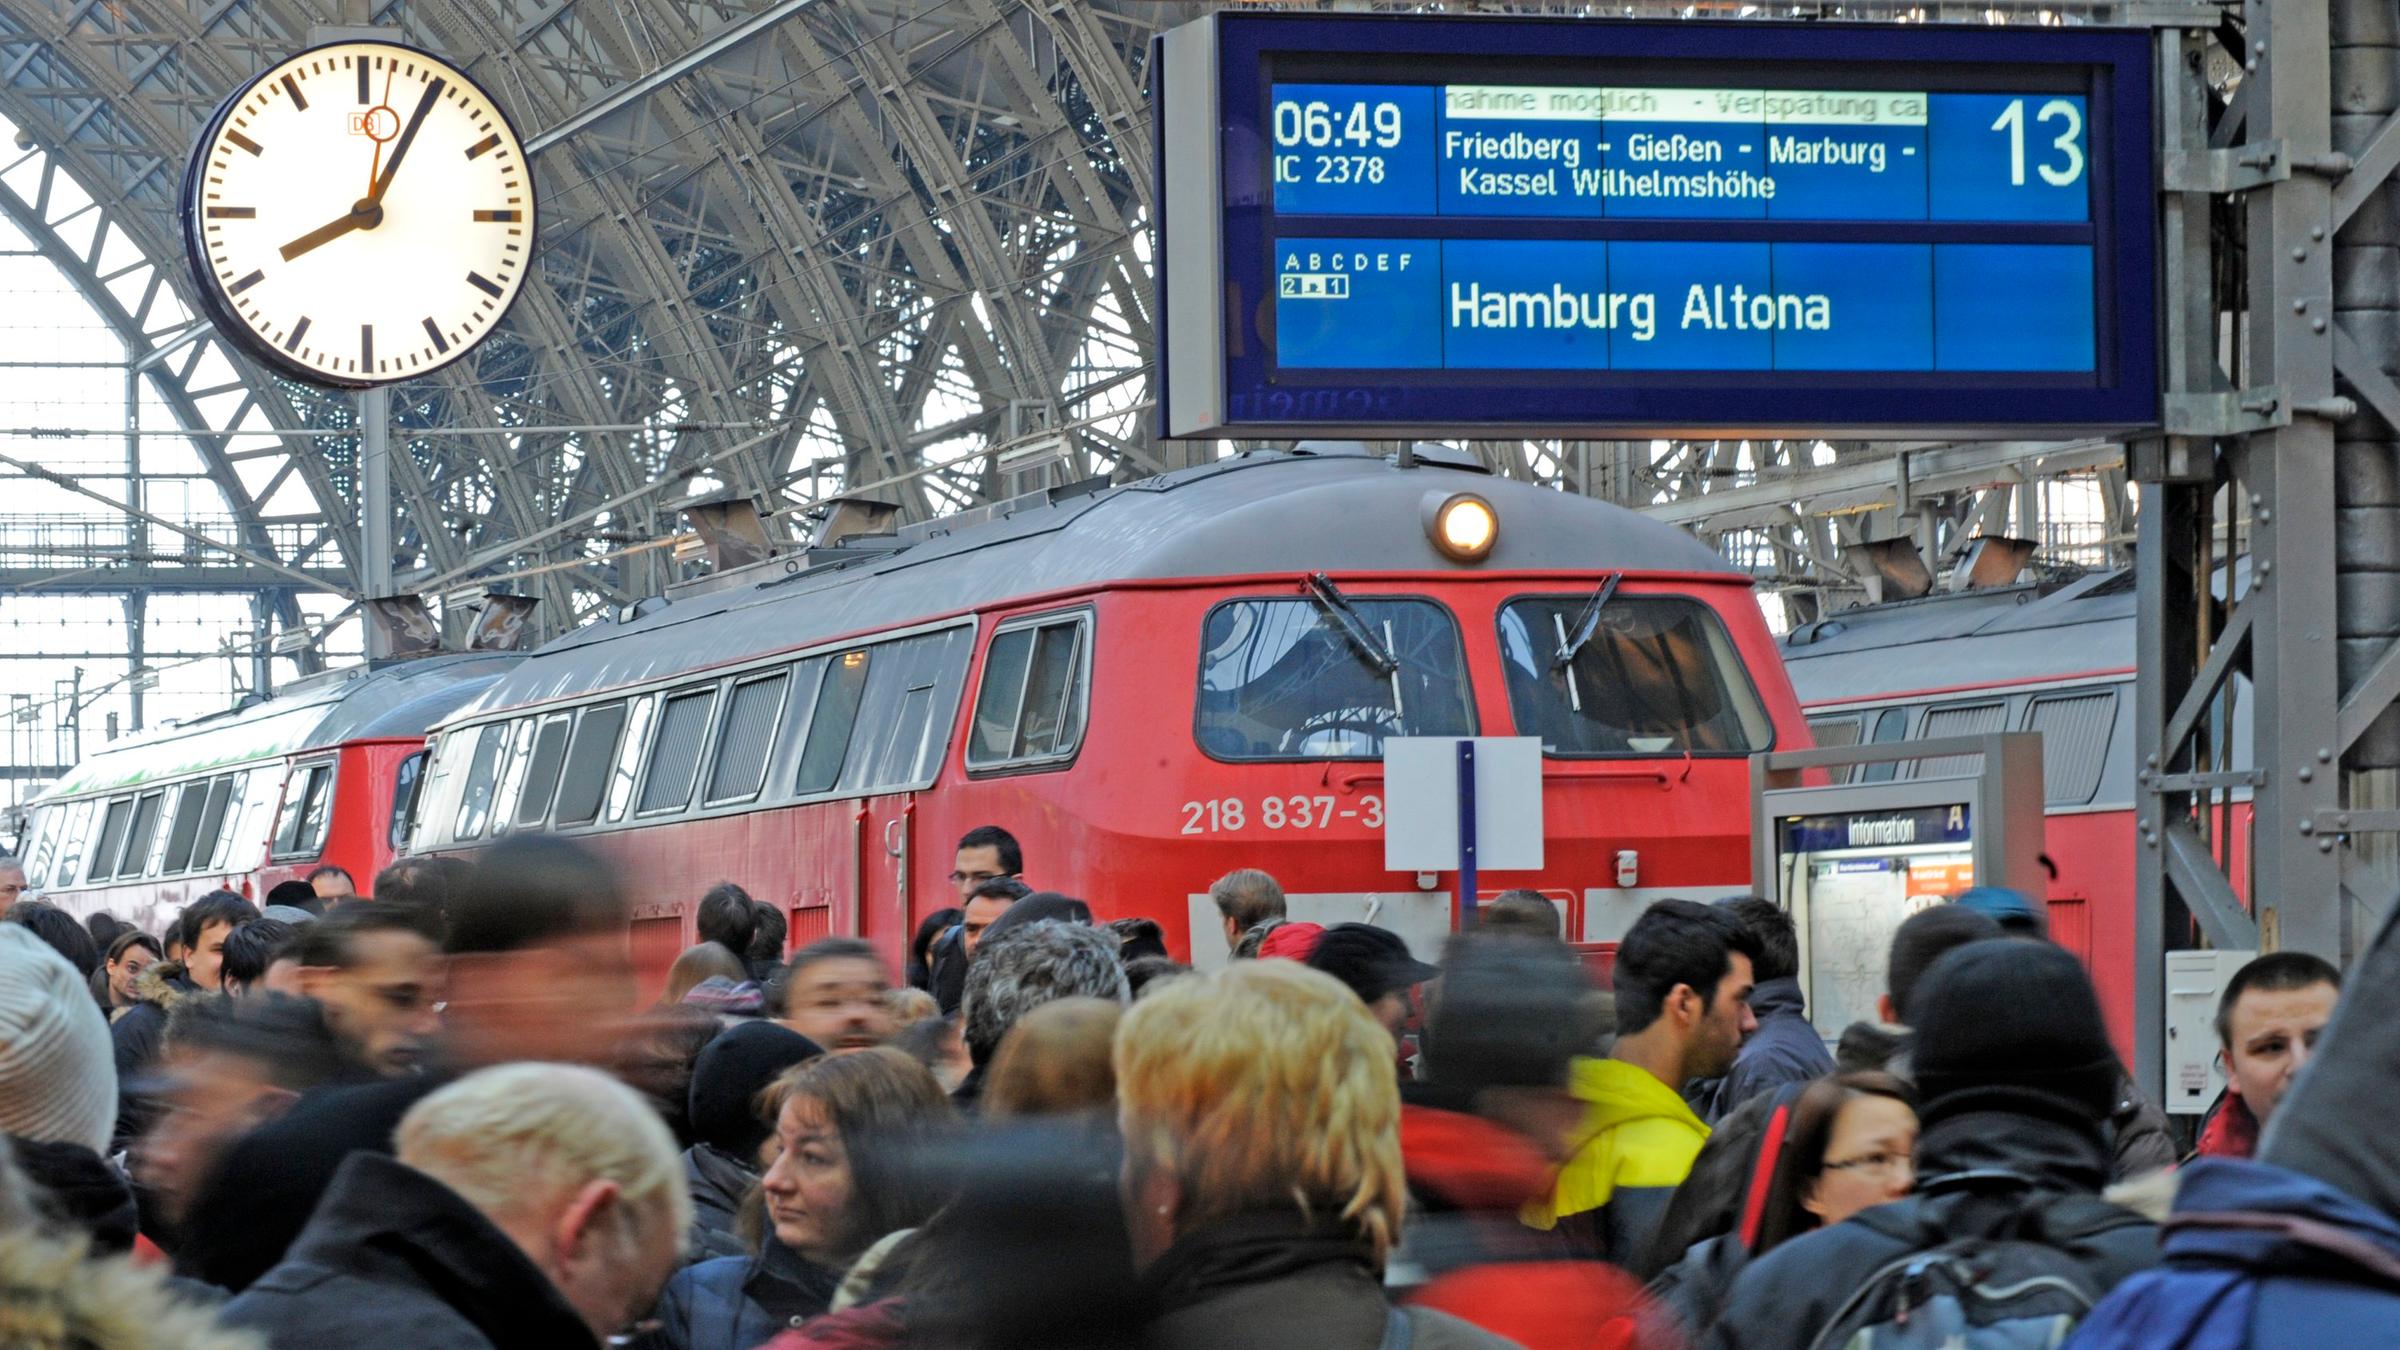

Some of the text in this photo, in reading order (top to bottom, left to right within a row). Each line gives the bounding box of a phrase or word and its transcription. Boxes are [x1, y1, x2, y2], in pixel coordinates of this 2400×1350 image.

[1275, 102, 1401, 148] 06:49
[1992, 101, 2083, 186] 13
[1275, 155, 1385, 184] IC 2378
[1446, 132, 1580, 168] Friedberg
[1629, 133, 1722, 162] Gießen
[1770, 136, 1886, 172] Marburg
[1460, 168, 1776, 199] Kassel Wilhelmshöhe
[1452, 282, 1830, 341] Hamburg Altona
[1181, 795, 1385, 835] 218 837-3
[1848, 805, 1964, 846] Information A
